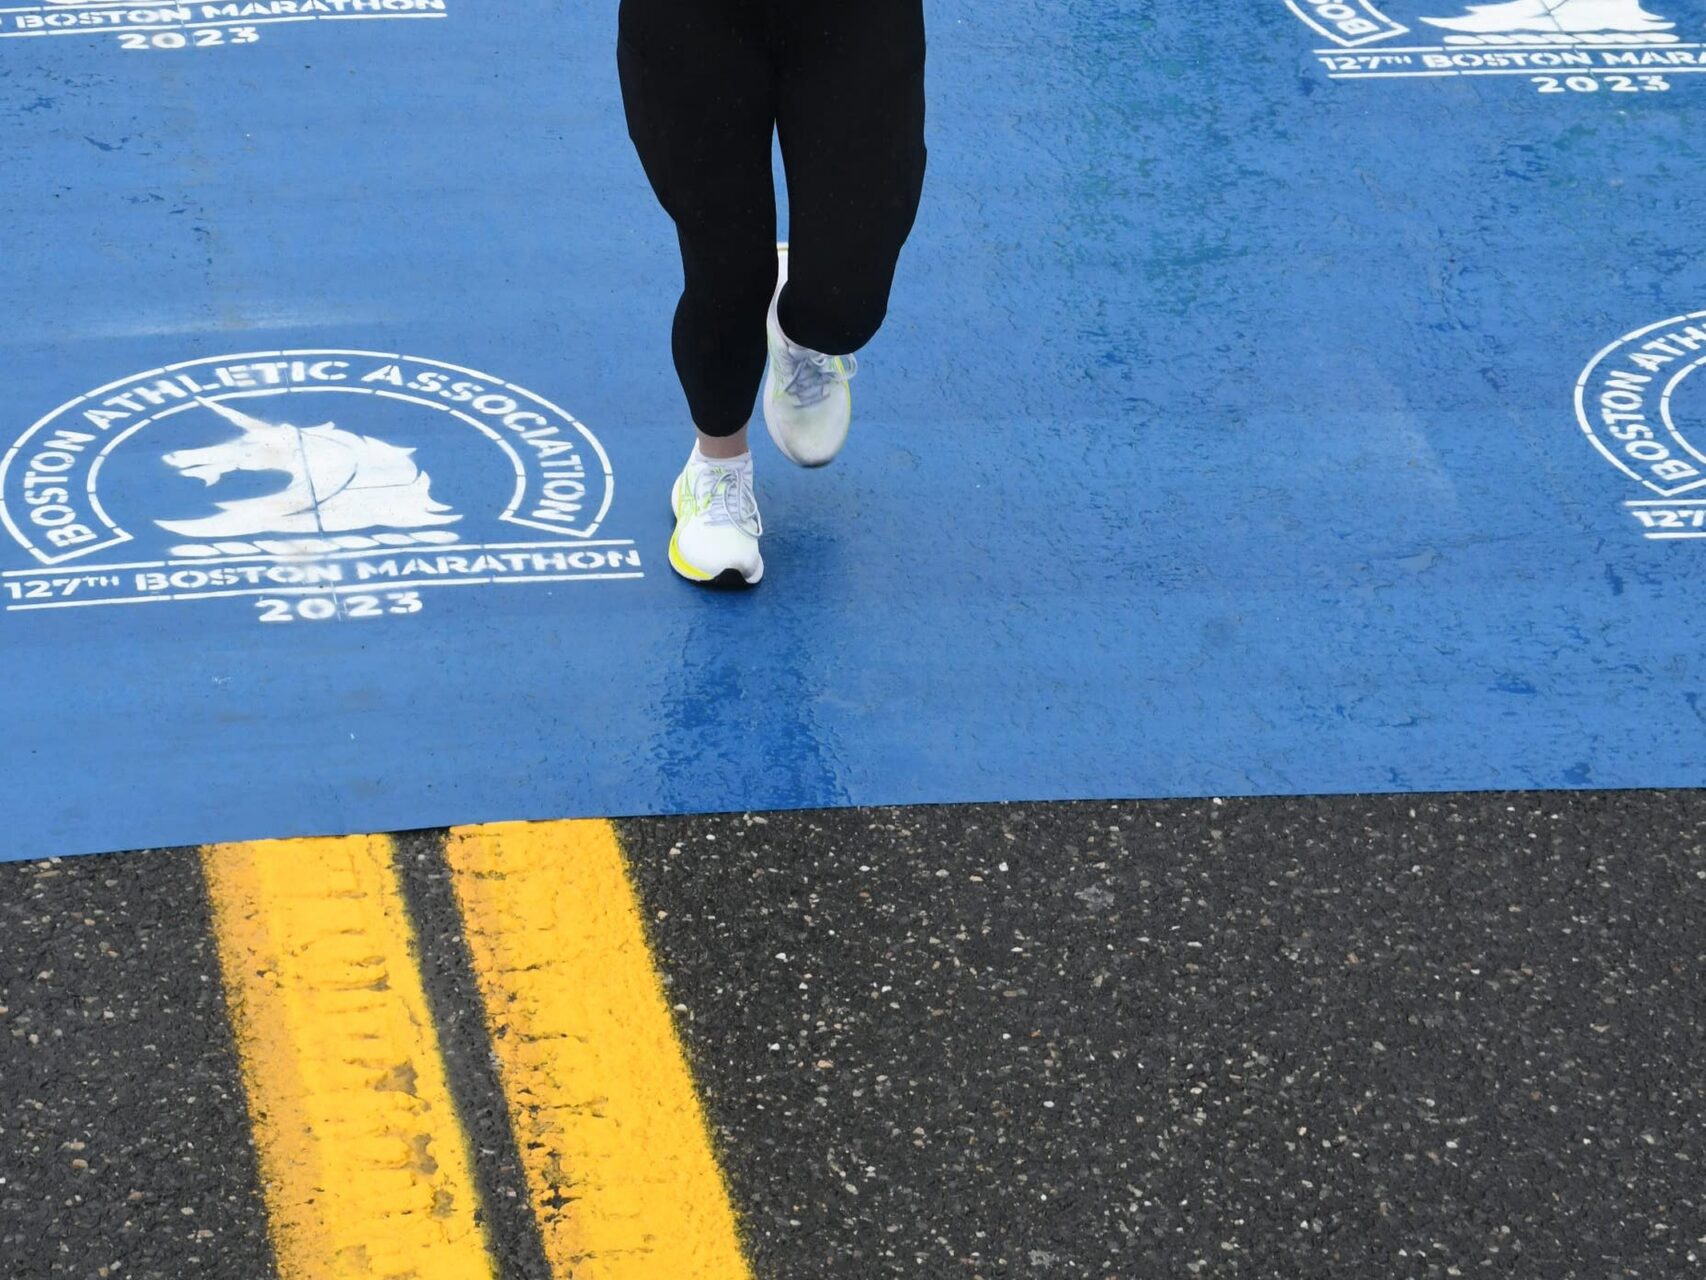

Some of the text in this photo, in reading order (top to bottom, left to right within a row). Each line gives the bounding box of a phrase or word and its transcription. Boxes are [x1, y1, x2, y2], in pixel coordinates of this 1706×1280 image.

[16, 7, 192, 29] BOSTON
[117, 26, 260, 50] 2023
[1421, 52, 1594, 69] BOSTON
[1531, 75, 1671, 93] 2023
[1601, 322, 1706, 481] BOSTON ATH
[24, 361, 586, 548] BOSTON ATHLETIC ASSOCIATION
[1632, 509, 1706, 527] 127
[4, 549, 641, 600] 127TH BOSTON MARATHON
[254, 591, 424, 622] 2023
